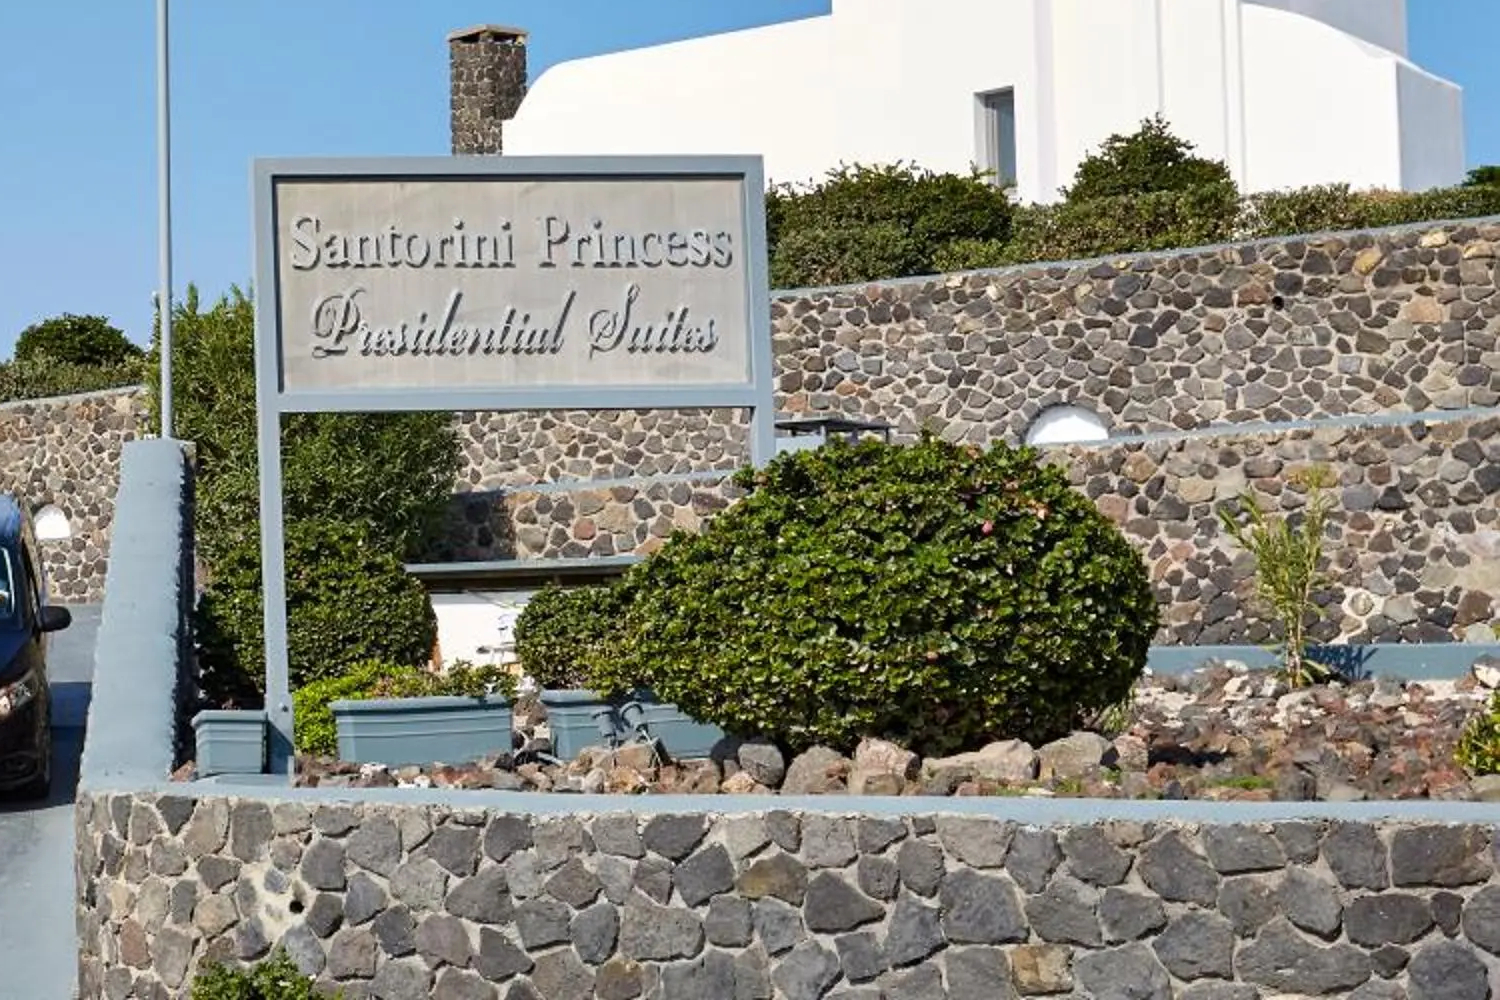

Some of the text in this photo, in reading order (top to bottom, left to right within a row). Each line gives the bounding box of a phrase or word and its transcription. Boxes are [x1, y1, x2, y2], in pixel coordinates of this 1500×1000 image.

[291, 216, 734, 270] Santorini Princess
[311, 283, 719, 360] Presidential Suites
